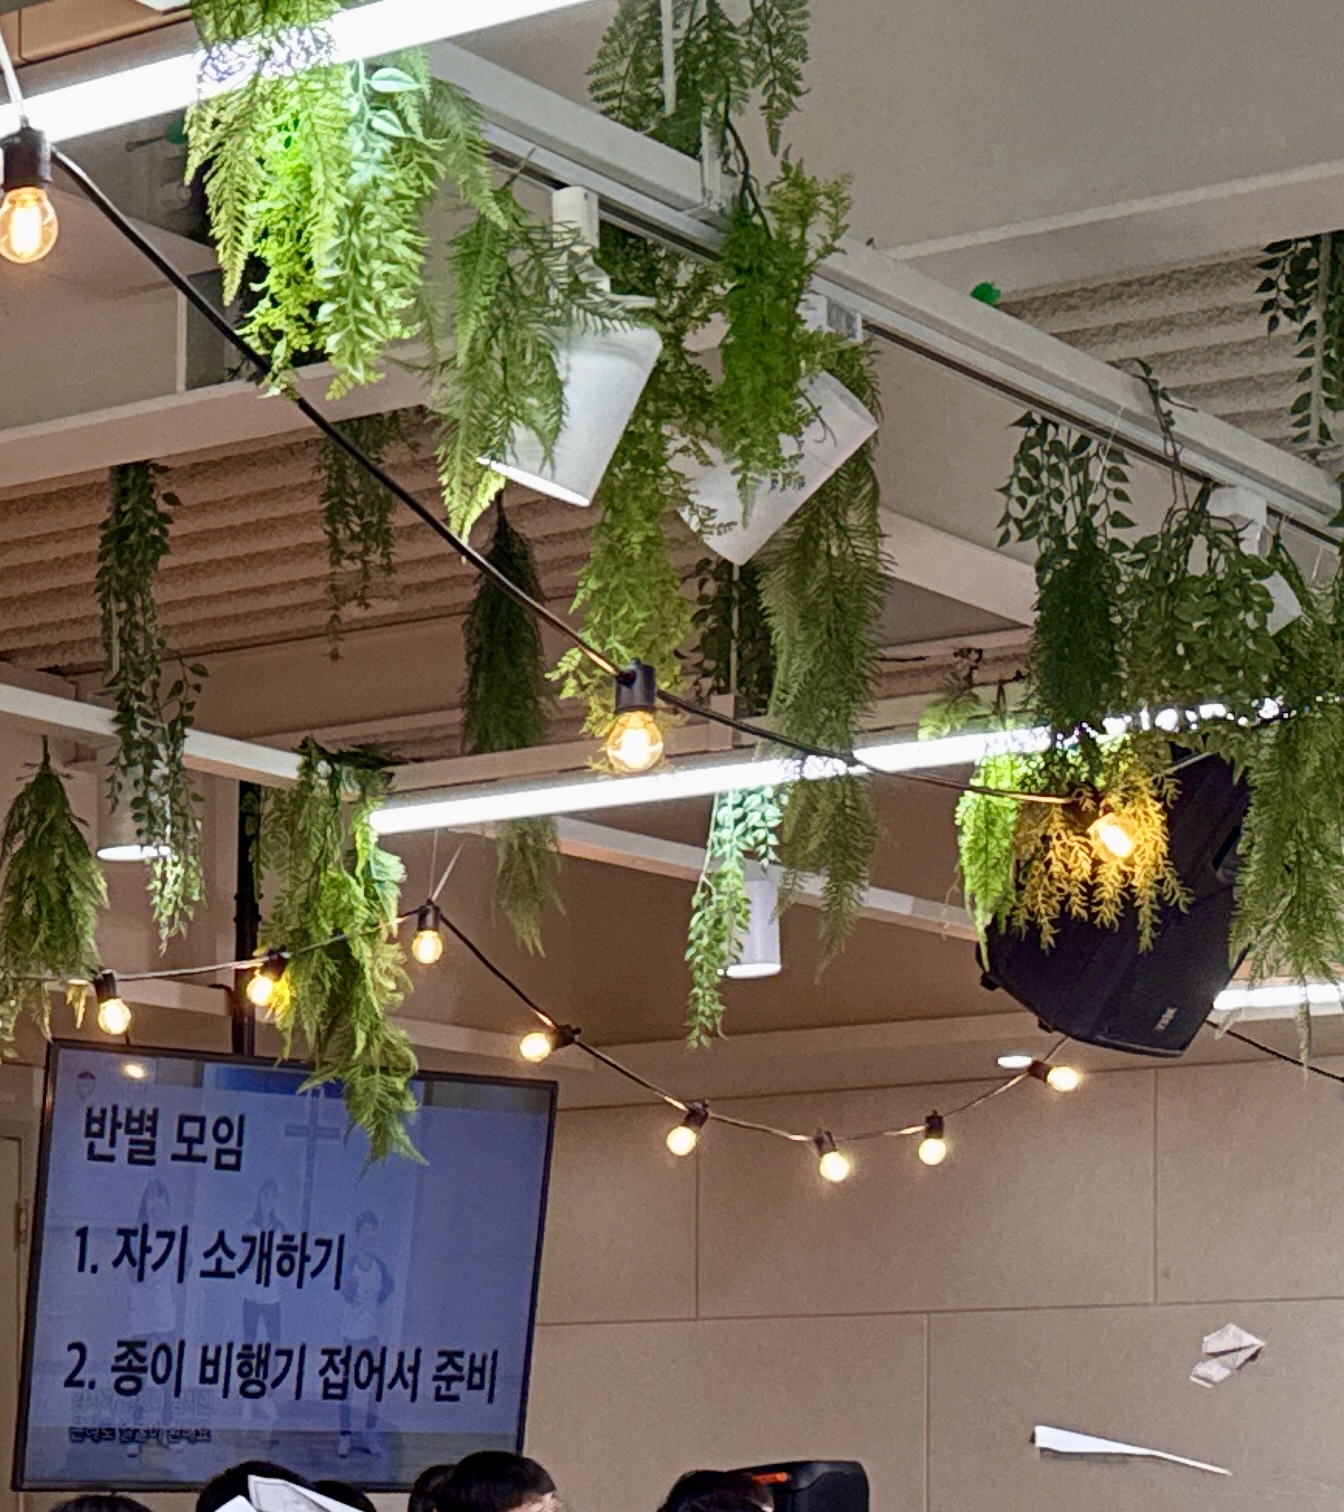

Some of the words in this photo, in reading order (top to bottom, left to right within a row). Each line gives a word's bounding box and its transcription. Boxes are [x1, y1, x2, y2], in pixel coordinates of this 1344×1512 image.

[84, 1103, 160, 1167] 반별
[170, 1113, 247, 1172] 모임
[74, 1225, 100, 1276] 1.
[111, 1222, 190, 1285] 자기
[199, 1229, 346, 1292] 소개하기
[63, 1341, 97, 1391] 2.
[110, 1339, 186, 1399] 종이
[198, 1341, 308, 1401] 비행기
[318, 1344, 424, 1404] 접어서
[431, 1348, 499, 1405] 준비
